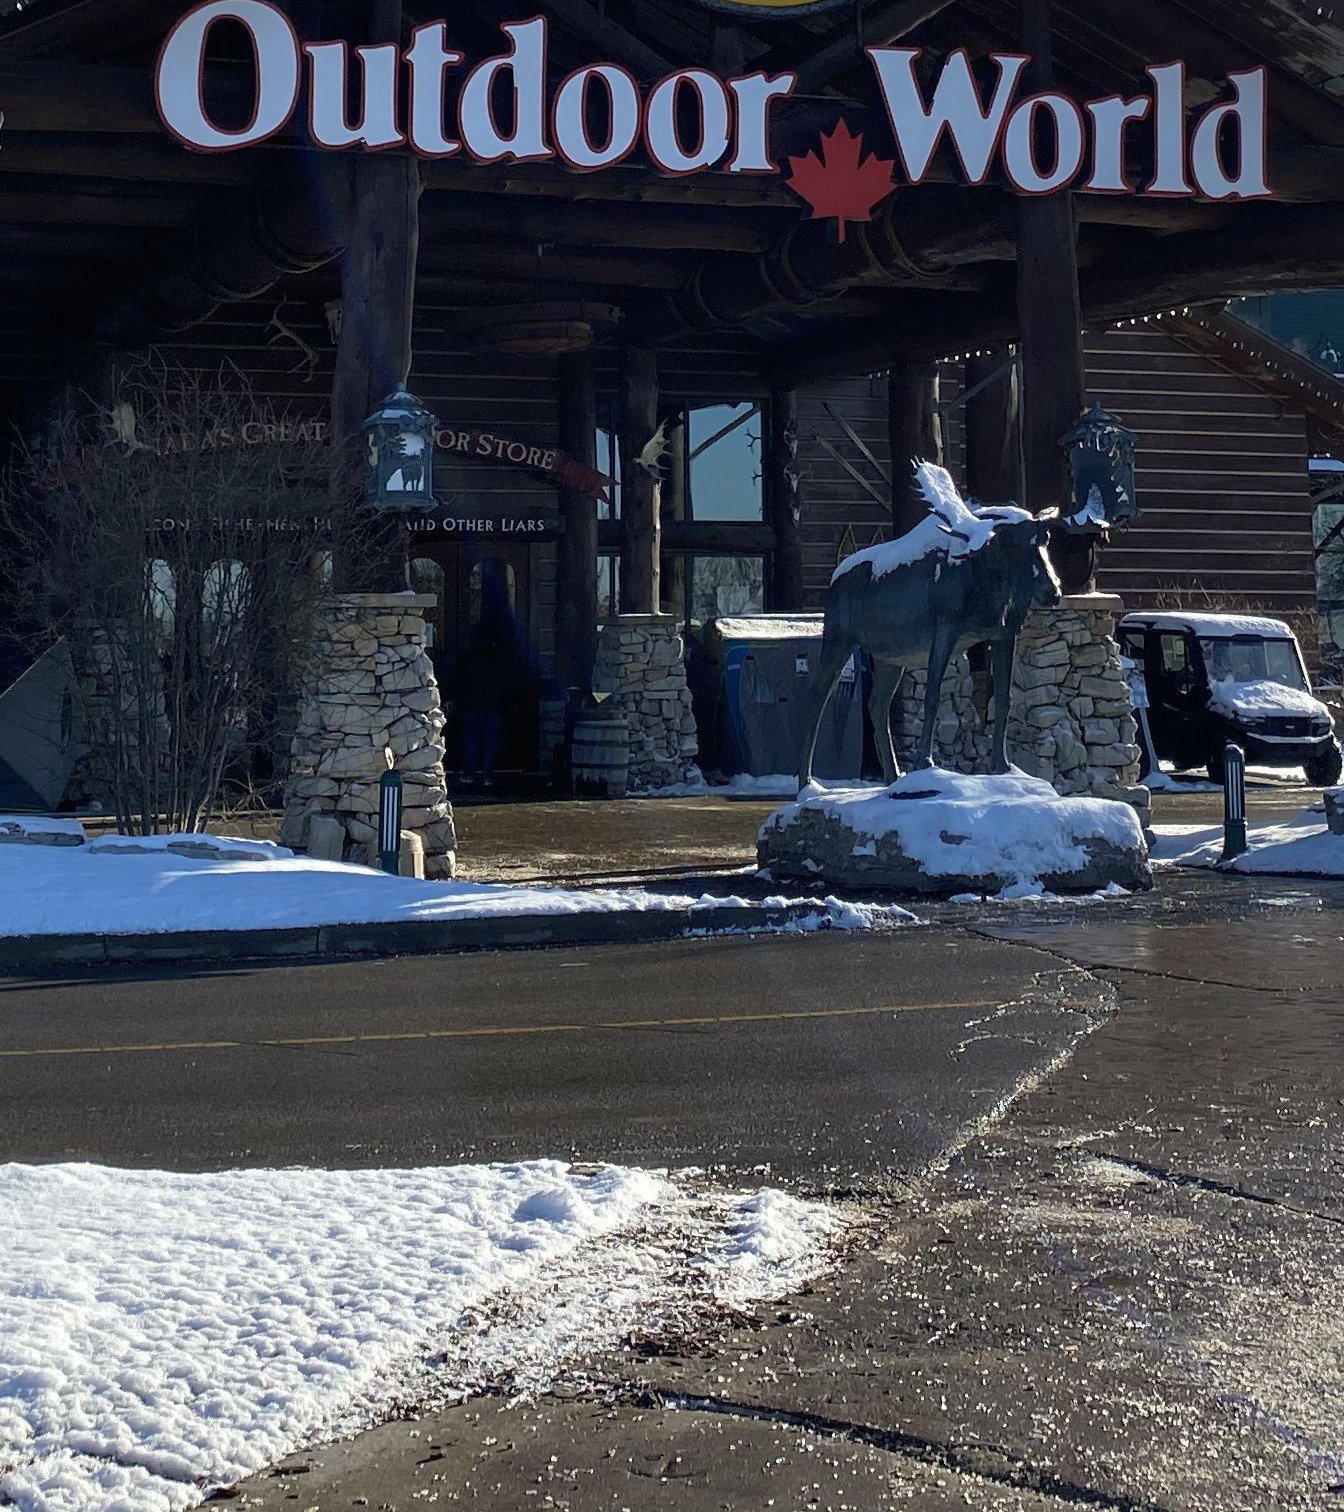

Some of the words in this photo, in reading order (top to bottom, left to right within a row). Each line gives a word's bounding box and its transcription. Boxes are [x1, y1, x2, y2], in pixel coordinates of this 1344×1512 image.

[864, 44, 1274, 201] World
[241, 420, 327, 445] GREAT
[475, 433, 557, 471] STORE
[442, 517, 494, 532] OTHER
[501, 518, 545, 532] LIARS
